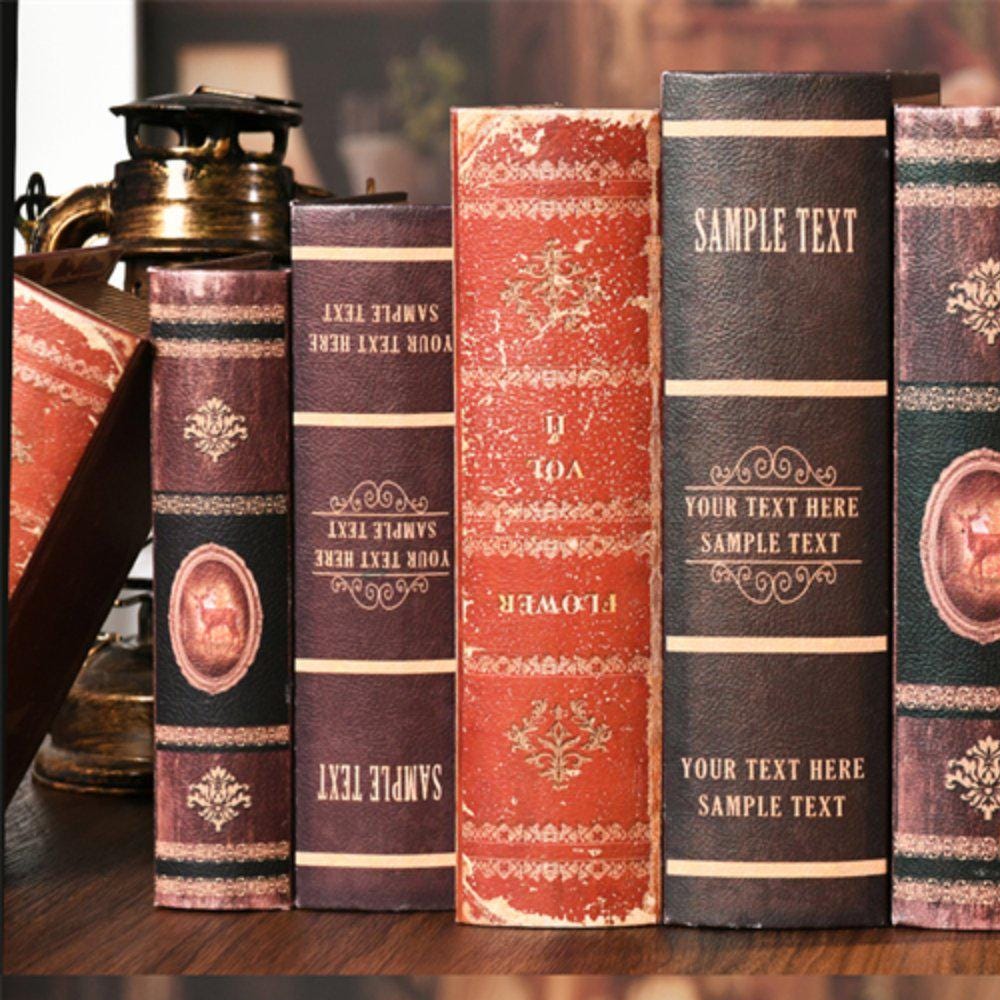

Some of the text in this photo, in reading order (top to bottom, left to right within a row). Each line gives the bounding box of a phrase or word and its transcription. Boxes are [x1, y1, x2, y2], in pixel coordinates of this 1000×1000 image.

[694, 206, 857, 253] SAMPLE TEXT
[321, 303, 440, 323] SAMPLE TEXT
[308, 333, 454, 353] YOUR TEXT HERE
[685, 496, 859, 517] YOUR TEXT HERE
[327, 521, 437, 538] SAMPLE TEXT
[700, 532, 841, 554] SAMPLE TEXT
[313, 550, 450, 567] YOUR TEXT HERE
[498, 593, 617, 616] FLOWER
[681, 757, 865, 781] YOUR TEXT HERE
[317, 763, 442, 801] SAMPLE TEXT
[698, 793, 846, 817] SAMPLE TEXT
